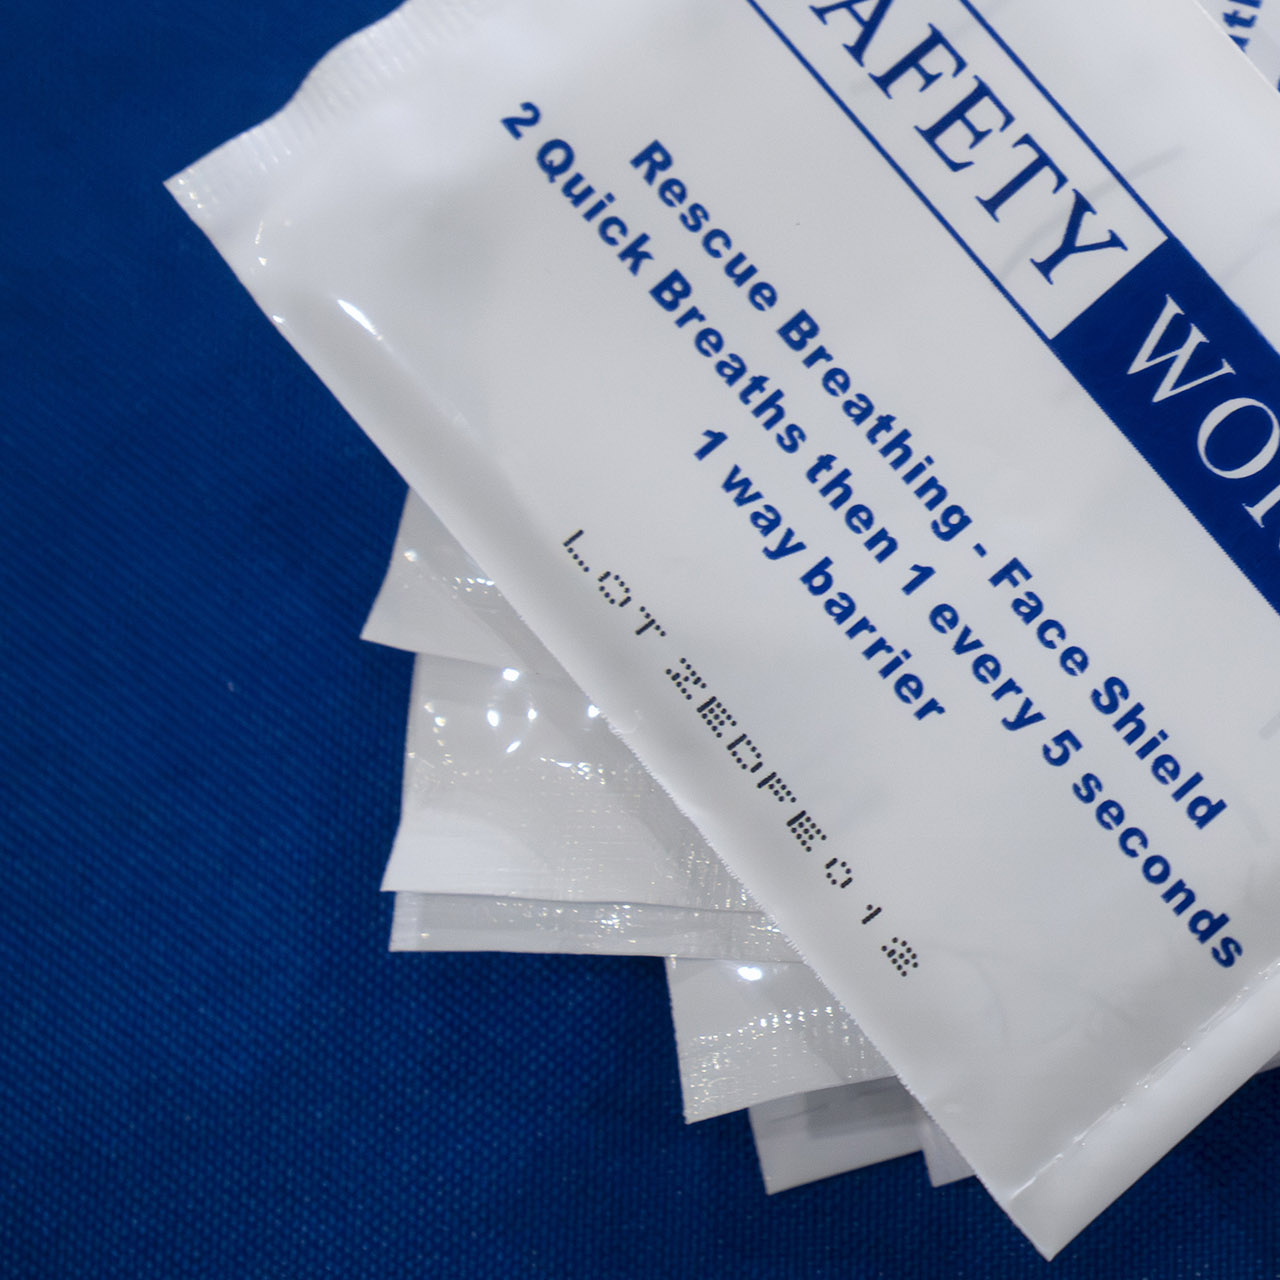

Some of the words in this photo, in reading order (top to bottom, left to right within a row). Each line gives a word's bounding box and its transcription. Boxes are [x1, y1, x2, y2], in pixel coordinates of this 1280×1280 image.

[500, 101, 542, 140] 2
[535, 138, 655, 275] Quick
[648, 269, 808, 455] Breaths
[805, 454, 900, 565] then
[899, 562, 936, 598] 1
[928, 600, 1046, 734] every
[1041, 728, 1085, 768] 5
[1071, 770, 1244, 972] seconds
[562, 529, 668, 638] LOT
[629, 140, 779, 312] Rescue
[777, 309, 974, 544] Breathing
[989, 556, 1091, 678] Face
[1090, 675, 1229, 830] Shield
[692, 427, 727, 462] 1
[720, 464, 808, 564] way
[800, 557, 948, 723] barrier
